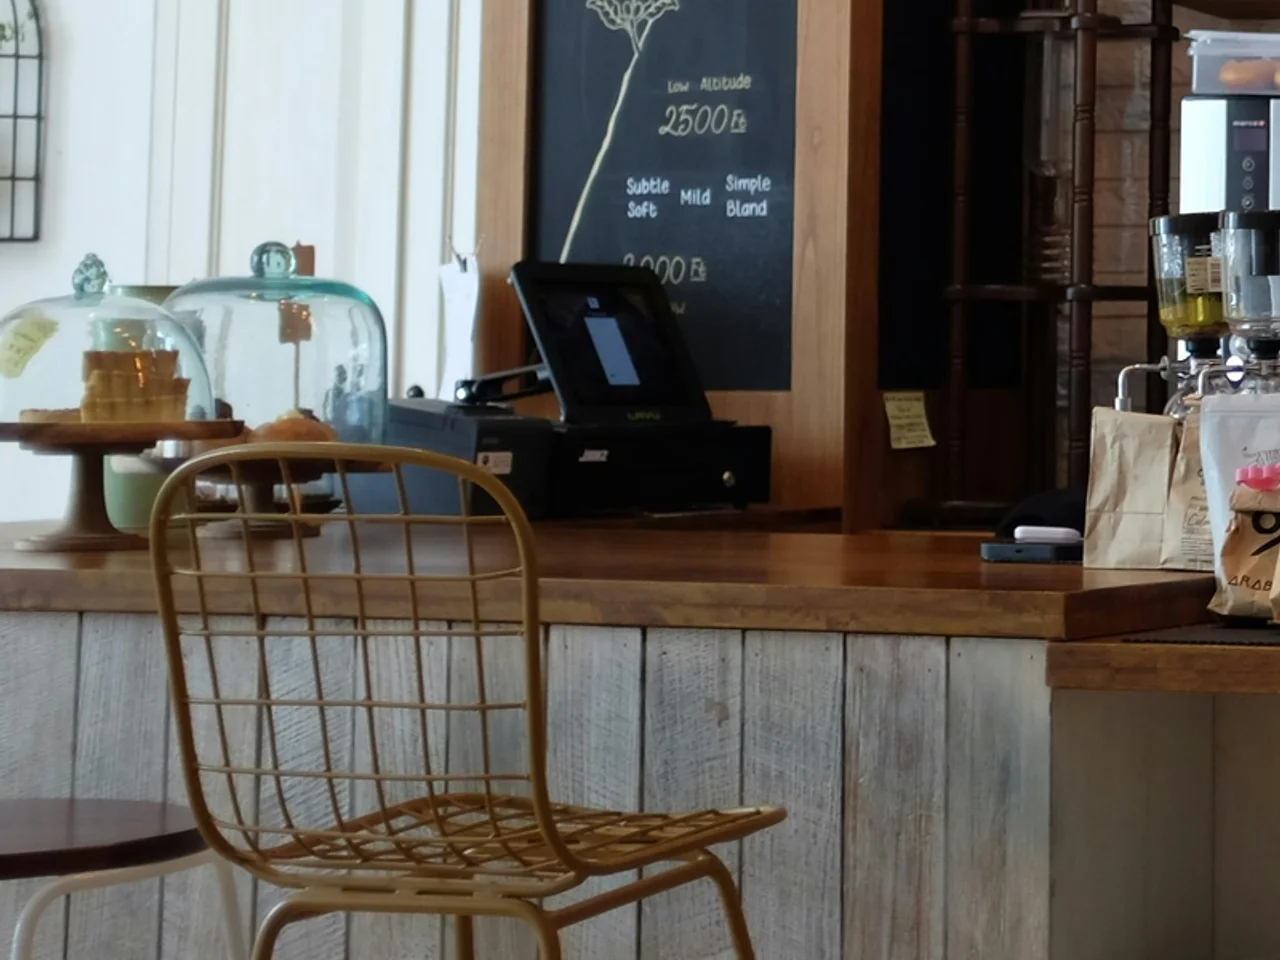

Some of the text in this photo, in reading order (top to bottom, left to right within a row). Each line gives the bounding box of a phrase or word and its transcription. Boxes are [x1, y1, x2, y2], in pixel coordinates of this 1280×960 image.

[699, 73, 753, 91] Altitude
[658, 104, 728, 137] 2500
[626, 178, 671, 196] Subtle
[725, 174, 772, 196] Simple
[680, 188, 711, 207] Mild
[627, 201, 659, 219] Soft
[726, 198, 768, 219] Bland
